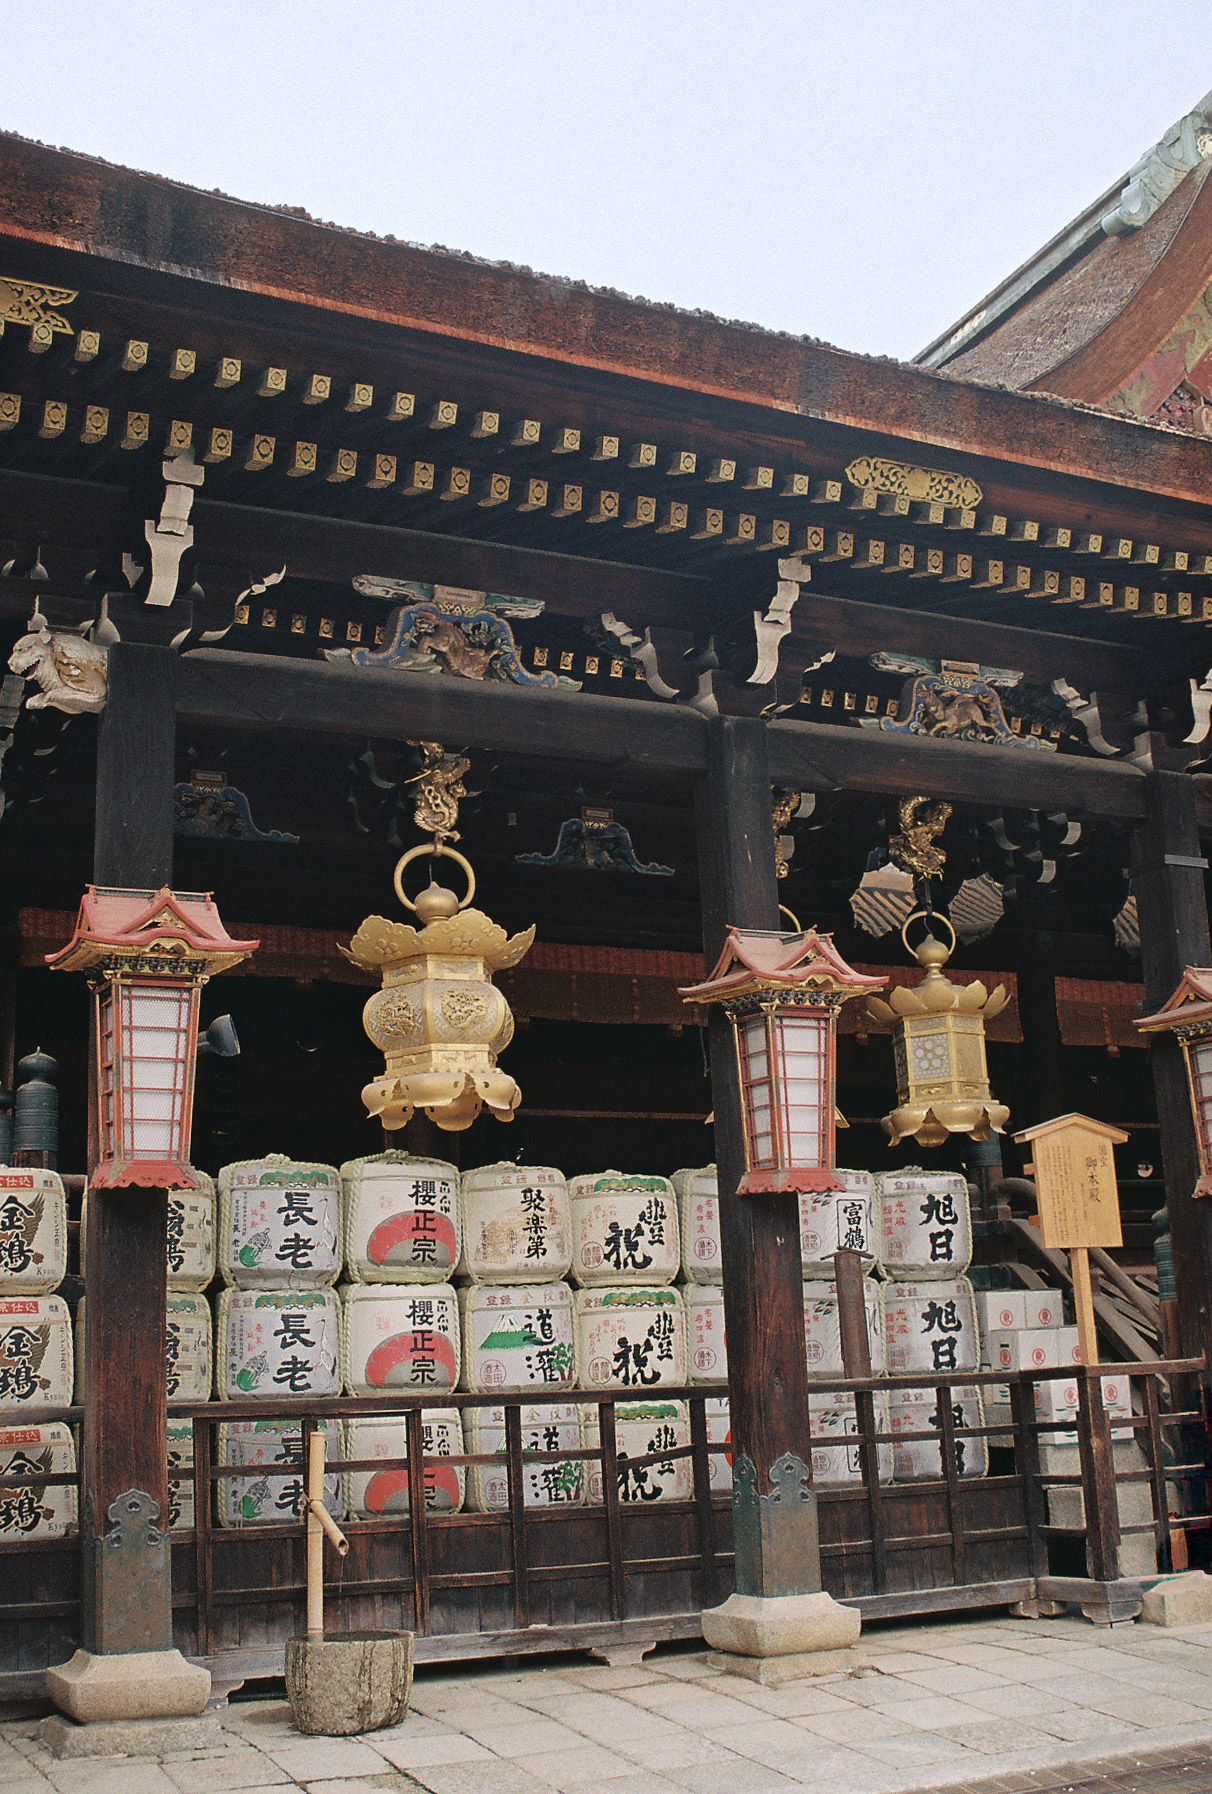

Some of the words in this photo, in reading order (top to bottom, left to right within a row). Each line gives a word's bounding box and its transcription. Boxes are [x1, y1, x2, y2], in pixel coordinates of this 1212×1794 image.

[0, 1176, 32, 1187] 仕込
[275, 1191, 318, 1269] 長老
[408, 1180, 437, 1263] 櫻正宗
[918, 1193, 959, 1262] 旭日
[273, 1314, 316, 1392] 長老
[405, 1300, 437, 1384] 櫻正宗
[920, 1300, 963, 1371] 旭日
